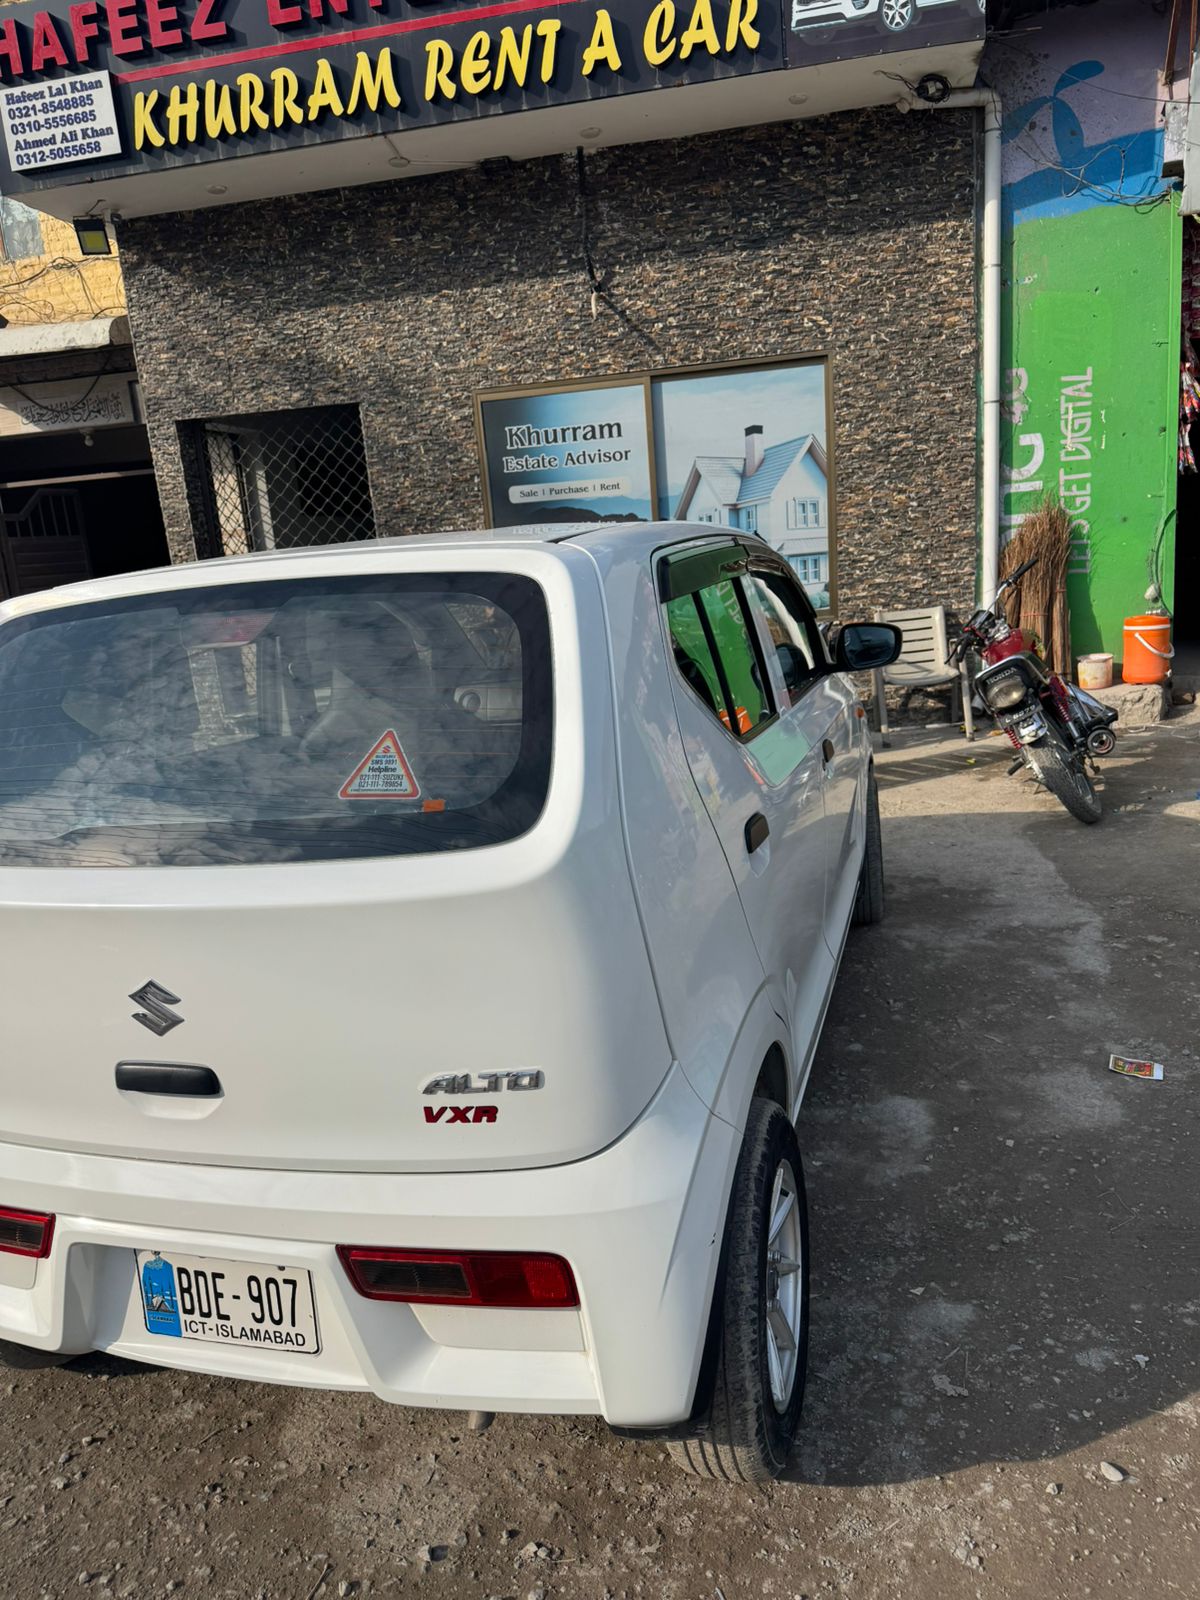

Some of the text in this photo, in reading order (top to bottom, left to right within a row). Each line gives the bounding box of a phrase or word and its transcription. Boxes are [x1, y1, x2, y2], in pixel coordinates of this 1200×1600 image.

[0, 0, 227, 77] HAFEEZ
[134, 0, 761, 150] KHURRAM RENT A CAR
[5, 79, 103, 105] Hafeez Lal Khan
[8, 94, 94, 120] 0321-8548885
[11, 110, 97, 135] 0310-5556685
[14, 126, 114, 151] Ahmed Ali Khan
[16, 141, 102, 166] 0312-5055658
[1060, 366, 1093, 461] DIGITAL
[505, 420, 623, 449] Khurram
[503, 447, 631, 473] Estate Advisor
[520, 482, 620, 498] Sale Purchase Rent
[1059, 468, 1092, 515] GET
[986, 667, 1017, 685] HONDA
[368, 766, 397, 774] Helpline
[422, 1069, 545, 1095] ALTO
[423, 1105, 499, 1124] VXR
[184, 1319, 306, 1347] ICT-ISLAMABAD
